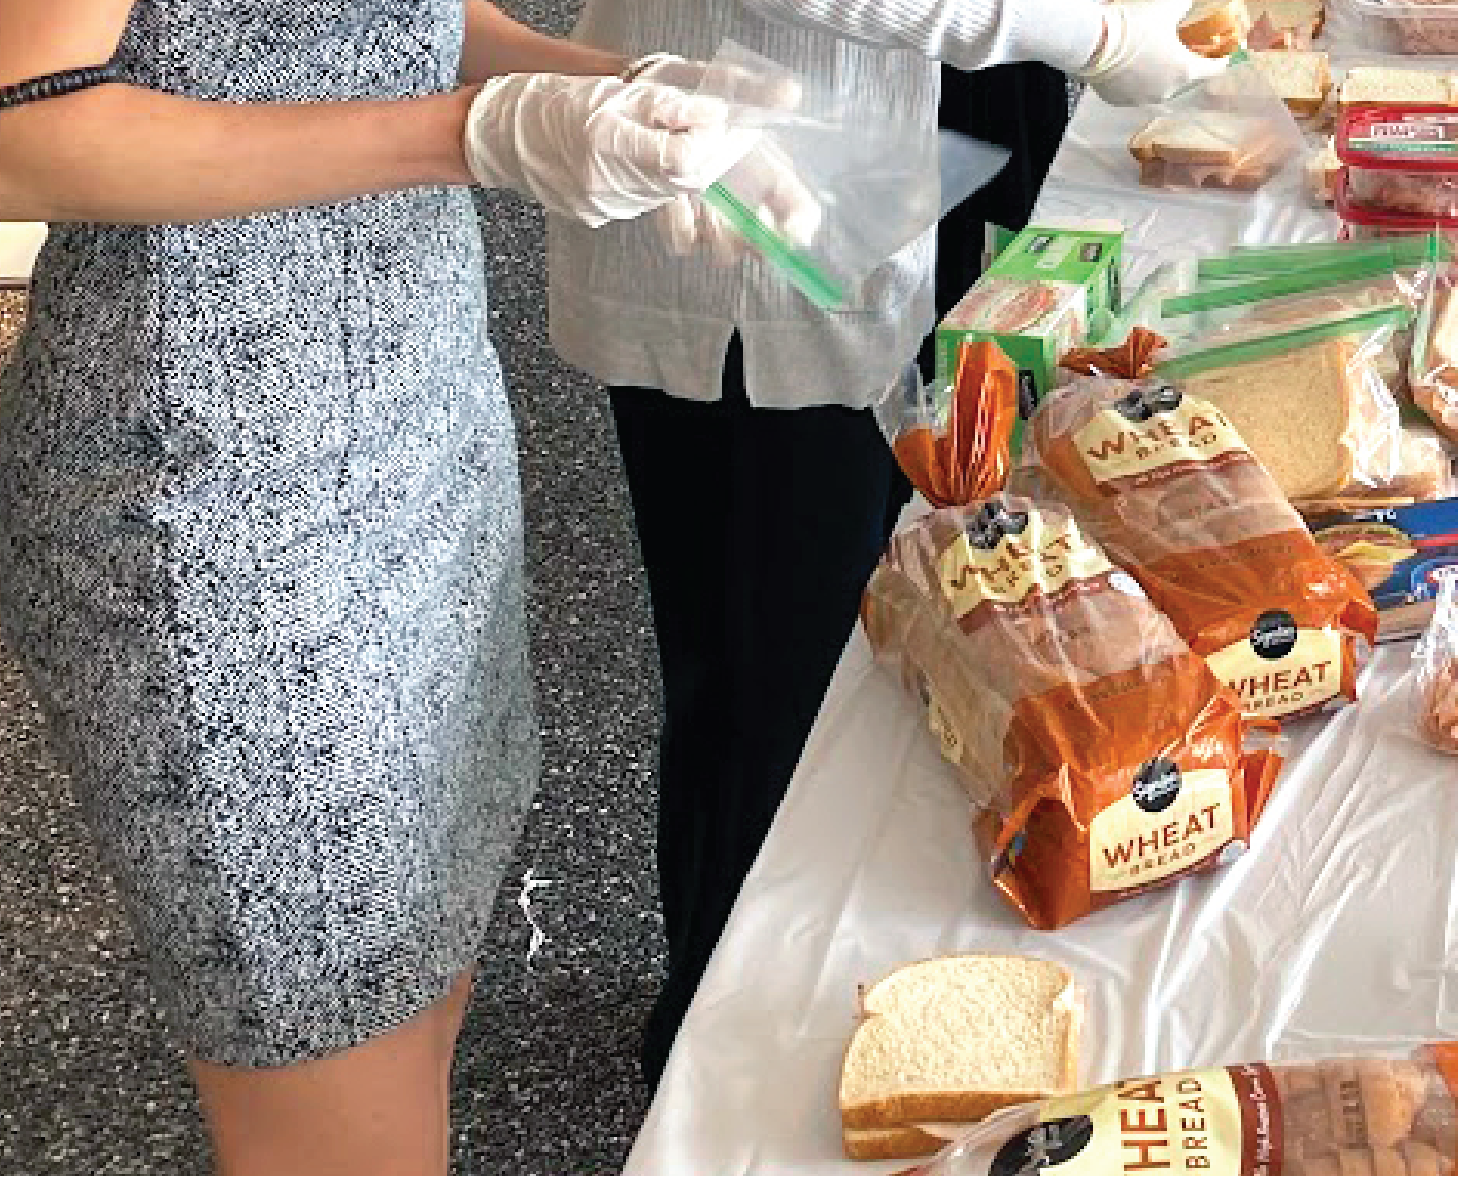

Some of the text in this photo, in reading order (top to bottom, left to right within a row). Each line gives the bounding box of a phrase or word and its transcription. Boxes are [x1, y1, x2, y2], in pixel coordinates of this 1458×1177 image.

[1101, 802, 1221, 869] WHEAT
[1129, 842, 1196, 876] BREAD
[1118, 1077, 1171, 1173] HEA
[1176, 1077, 1215, 1169] BREAD
